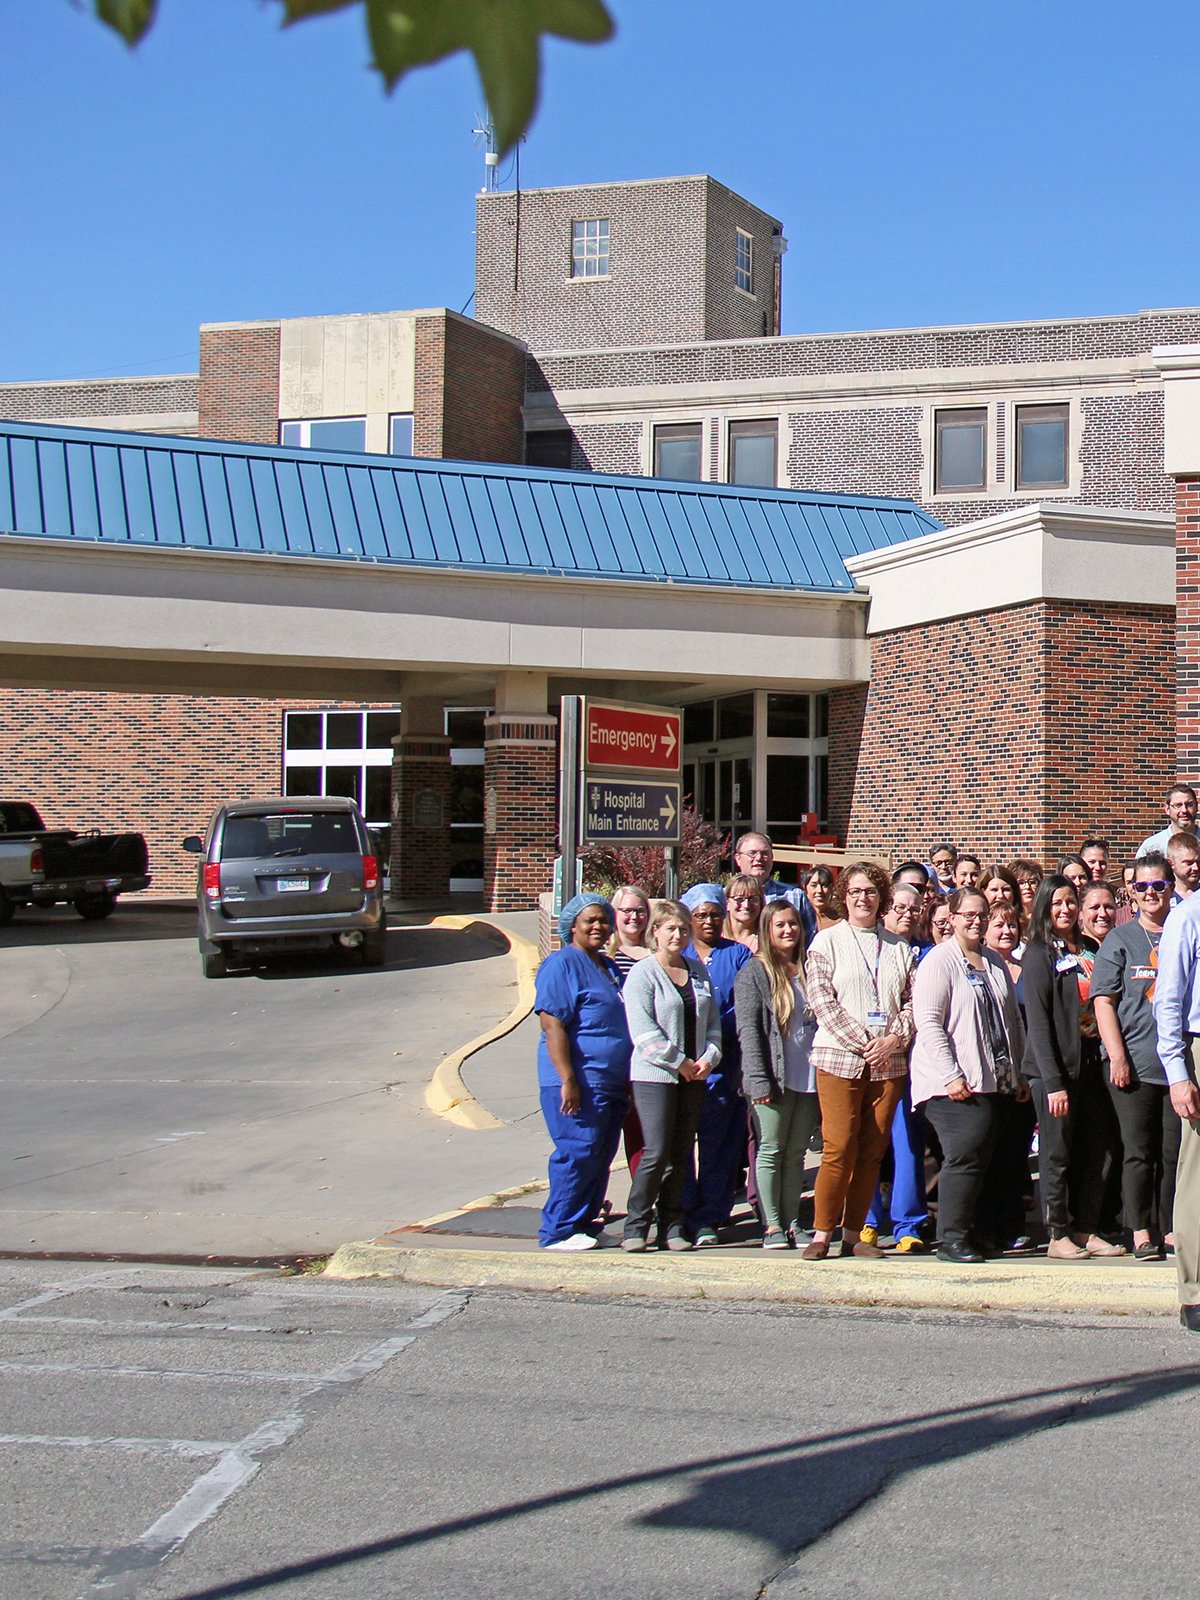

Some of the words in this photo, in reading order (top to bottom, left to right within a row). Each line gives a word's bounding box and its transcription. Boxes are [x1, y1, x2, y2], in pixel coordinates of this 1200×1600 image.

[590, 722, 657, 753] Emergency
[604, 790, 646, 811] Hospital
[588, 813, 612, 831] Main
[616, 814, 660, 831] Entrance
[1133, 965, 1156, 978] Team
